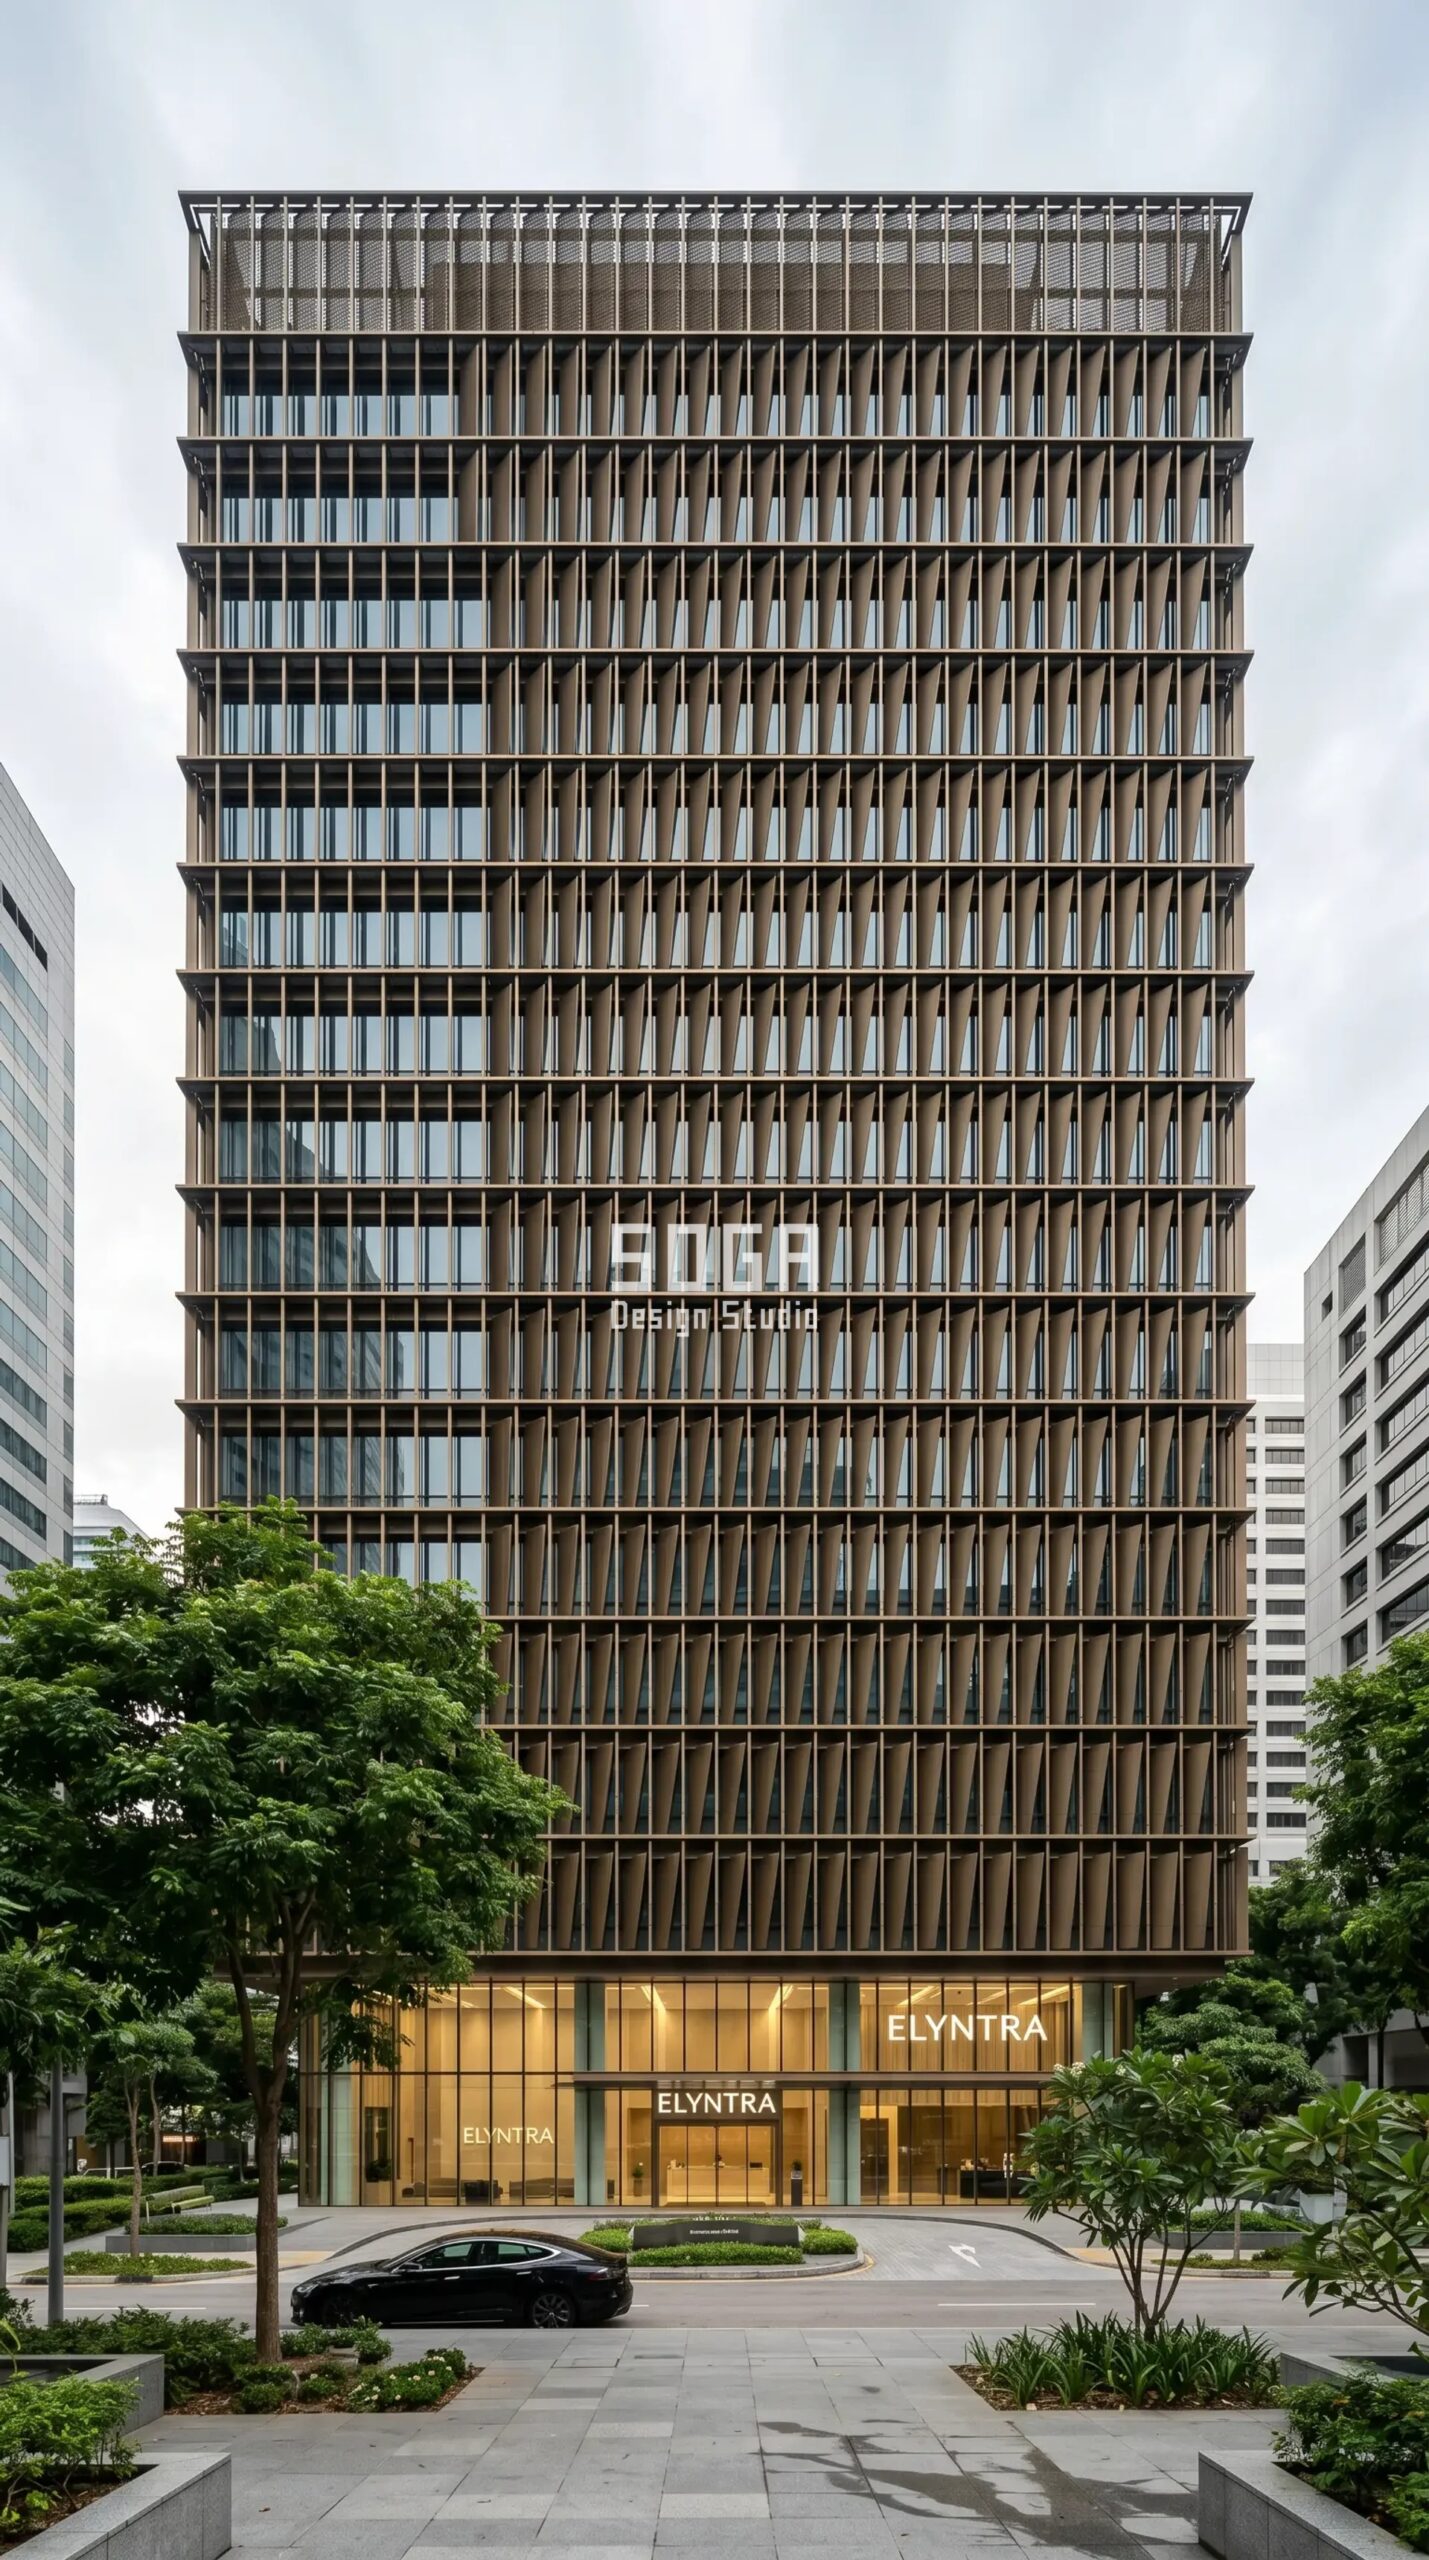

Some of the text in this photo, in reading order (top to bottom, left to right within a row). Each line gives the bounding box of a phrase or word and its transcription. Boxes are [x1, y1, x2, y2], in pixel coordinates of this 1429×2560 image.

[888, 2014, 1048, 2041] ELYNTRA
[658, 2092, 777, 2114] ELYNTRA
[463, 2127, 555, 2144] ELYNTRA
